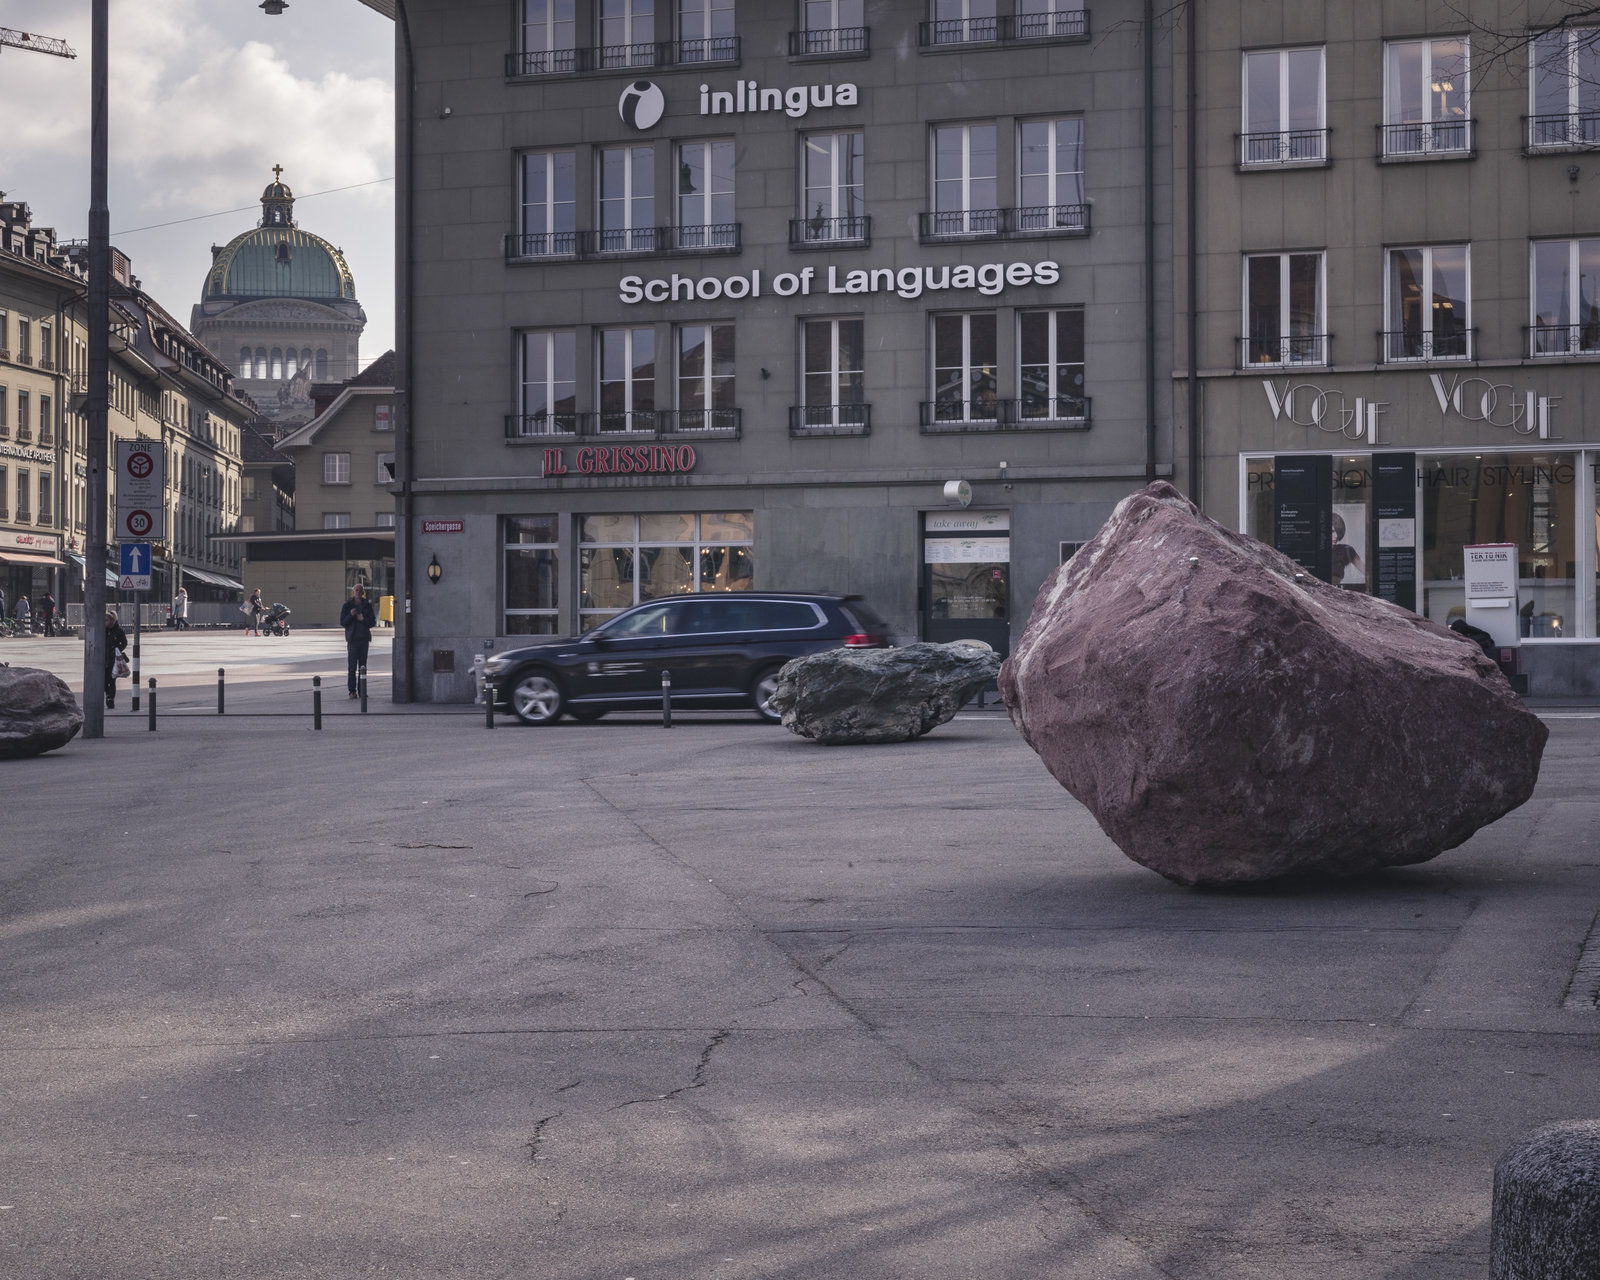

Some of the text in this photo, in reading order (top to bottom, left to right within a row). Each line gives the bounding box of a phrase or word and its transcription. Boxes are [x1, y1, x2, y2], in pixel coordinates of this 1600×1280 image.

[699, 79, 859, 118] inlingua
[619, 260, 1060, 304] School of Languages
[1262, 379, 1391, 445] VOGUE
[1429, 373, 1563, 440] VOGUE
[0, 444, 56, 463] TERNATIONALE APOTHEKE
[129, 443, 152, 453] ZONE
[543, 445, 696, 474] IL GRISSINO
[1417, 466, 1470, 488] HAIR
[1482, 464, 1576, 487] STYLING
[133, 518, 145, 528] 30
[425, 521, 462, 533] Speichergasse
[933, 519, 979, 530] take away
